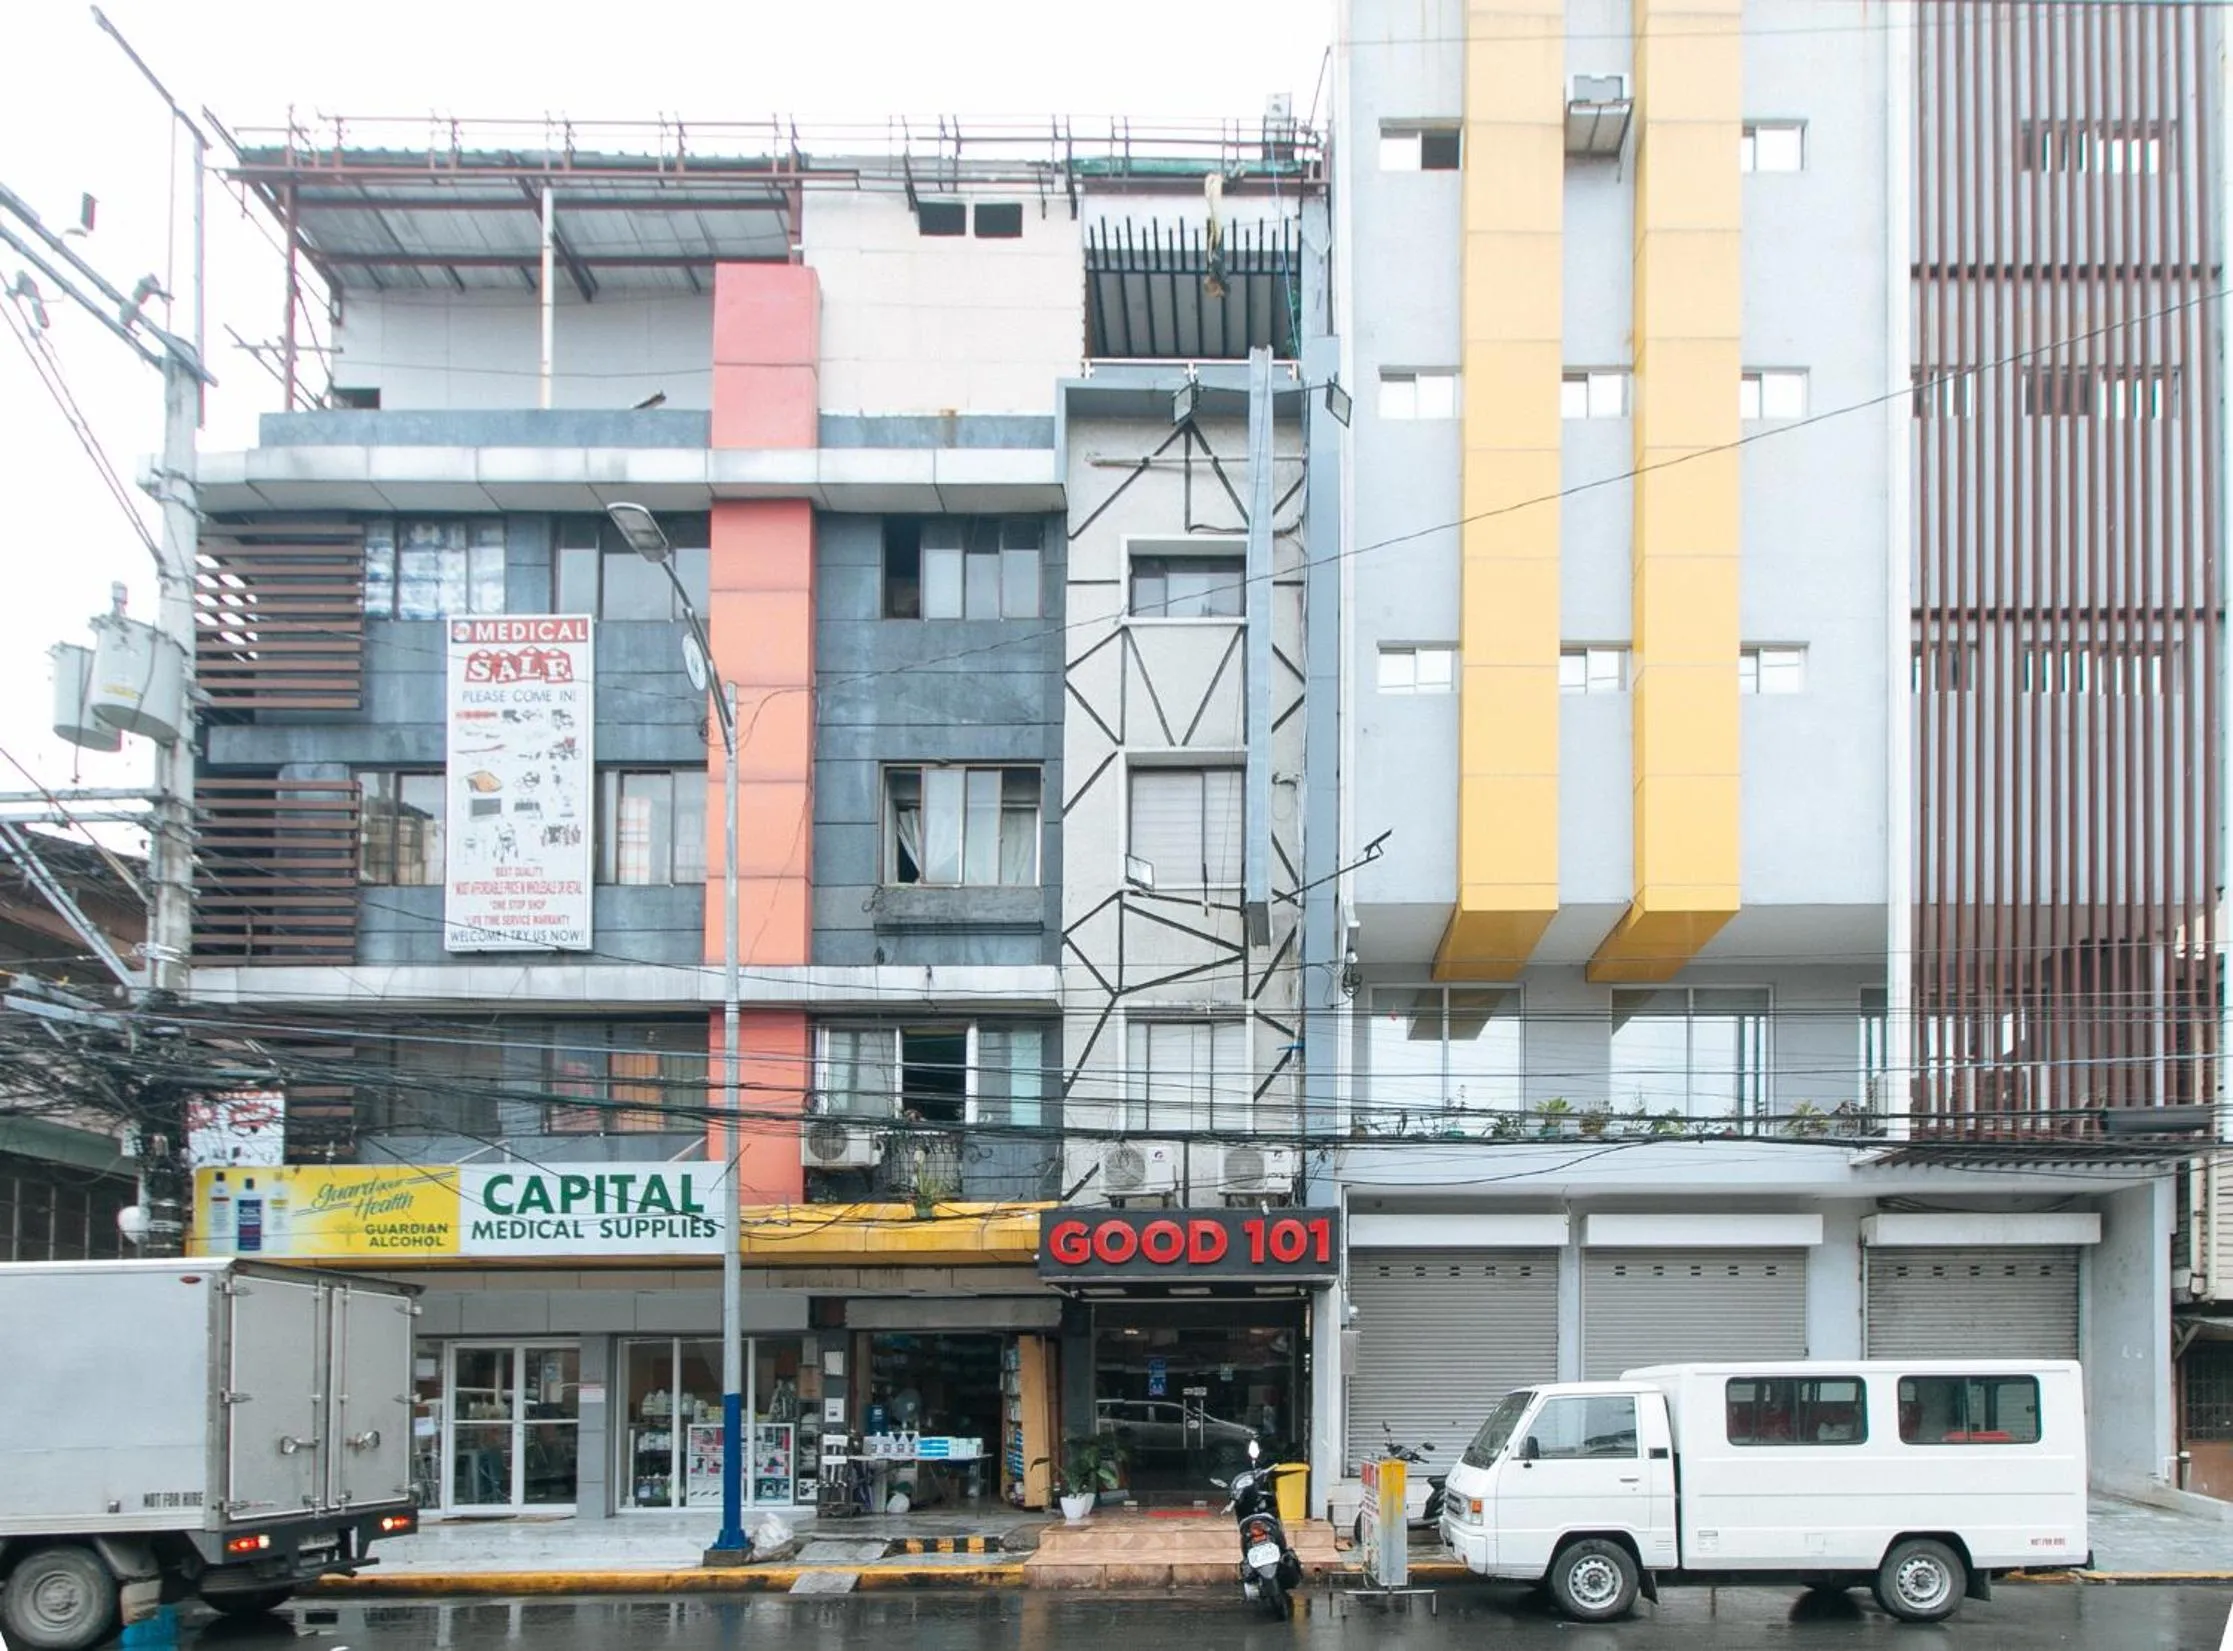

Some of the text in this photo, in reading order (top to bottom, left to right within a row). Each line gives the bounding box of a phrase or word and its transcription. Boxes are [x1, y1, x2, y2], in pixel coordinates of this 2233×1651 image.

[475, 621, 586, 641] MEDICAL
[468, 654, 572, 681] SALE
[462, 690, 506, 703] PLEASE
[513, 690, 552, 703] COME
[511, 928, 529, 942] TRY
[534, 928, 547, 942] US
[550, 927, 585, 941] NOW!
[482, 1173, 705, 1216] CAPITAL
[353, 1191, 414, 1221] Health
[364, 1223, 449, 1235] GUARDIAN
[471, 1218, 718, 1240] MEDICAL SUPPLIES
[369, 1236, 445, 1248] ALCOHOL
[1049, 1217, 1332, 1264] GOOD 101
[143, 1492, 204, 1508] NOT FOR HIRE
